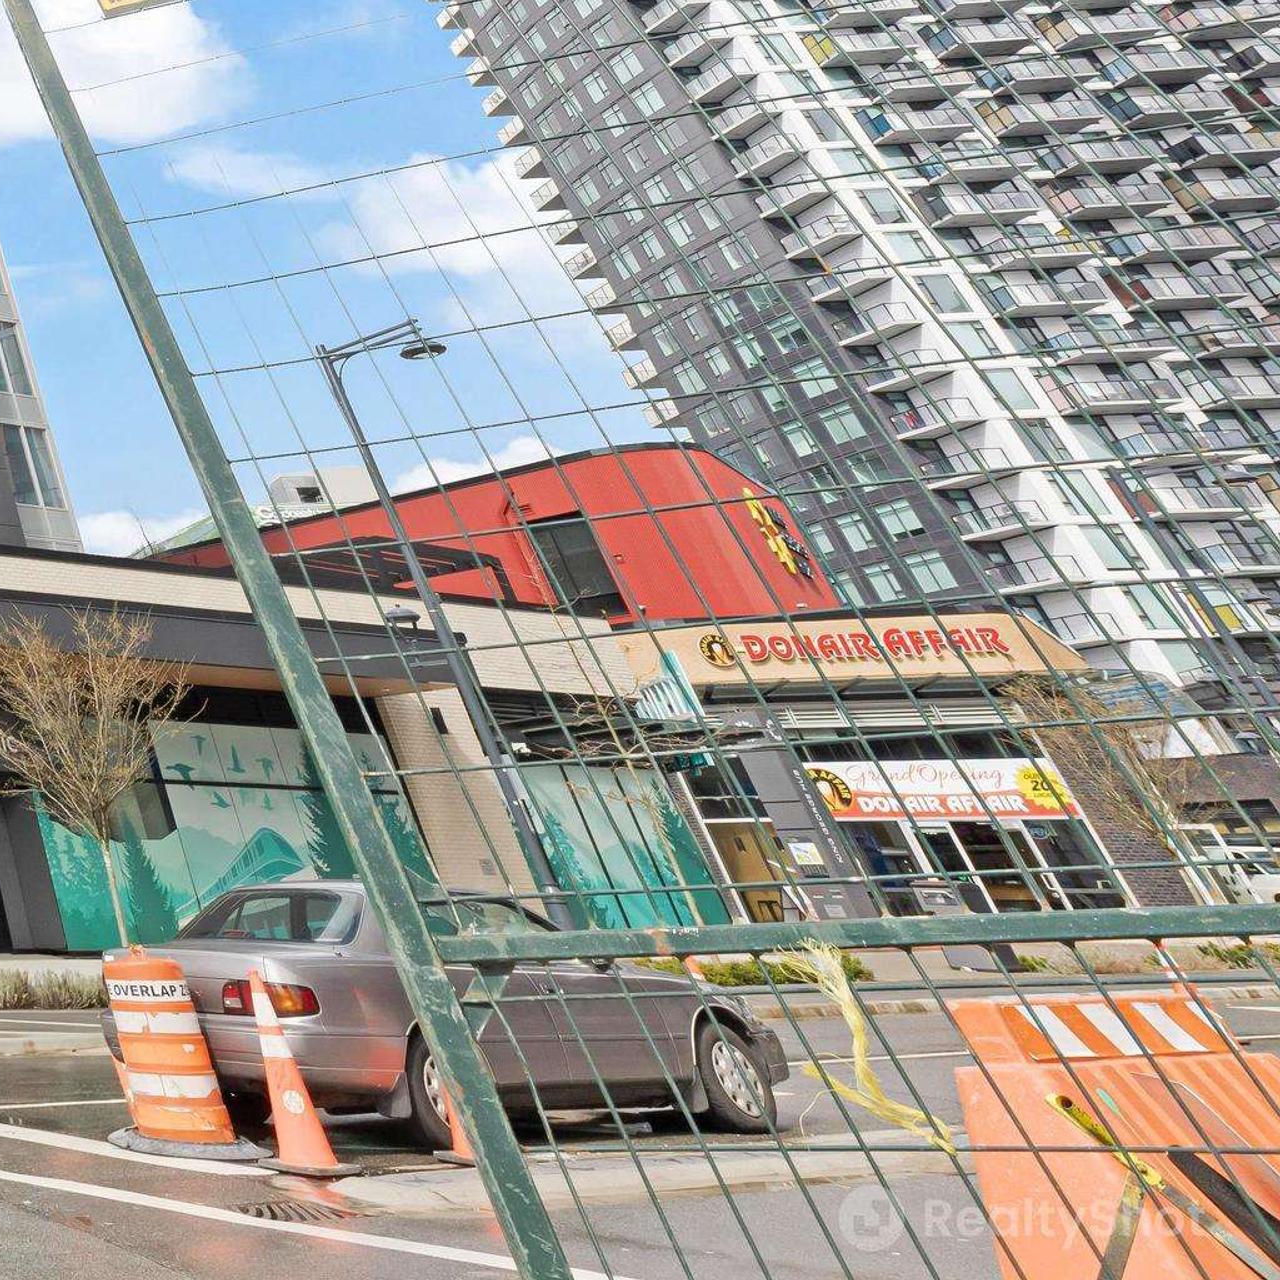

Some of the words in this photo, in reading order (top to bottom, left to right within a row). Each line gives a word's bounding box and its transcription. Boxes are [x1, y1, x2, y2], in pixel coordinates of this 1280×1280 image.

[740, 632, 881, 661] DONAIR
[883, 626, 1010, 659] AFFAIR
[916, 764, 1004, 789] Opeing
[113, 984, 177, 997] OVERLAP
